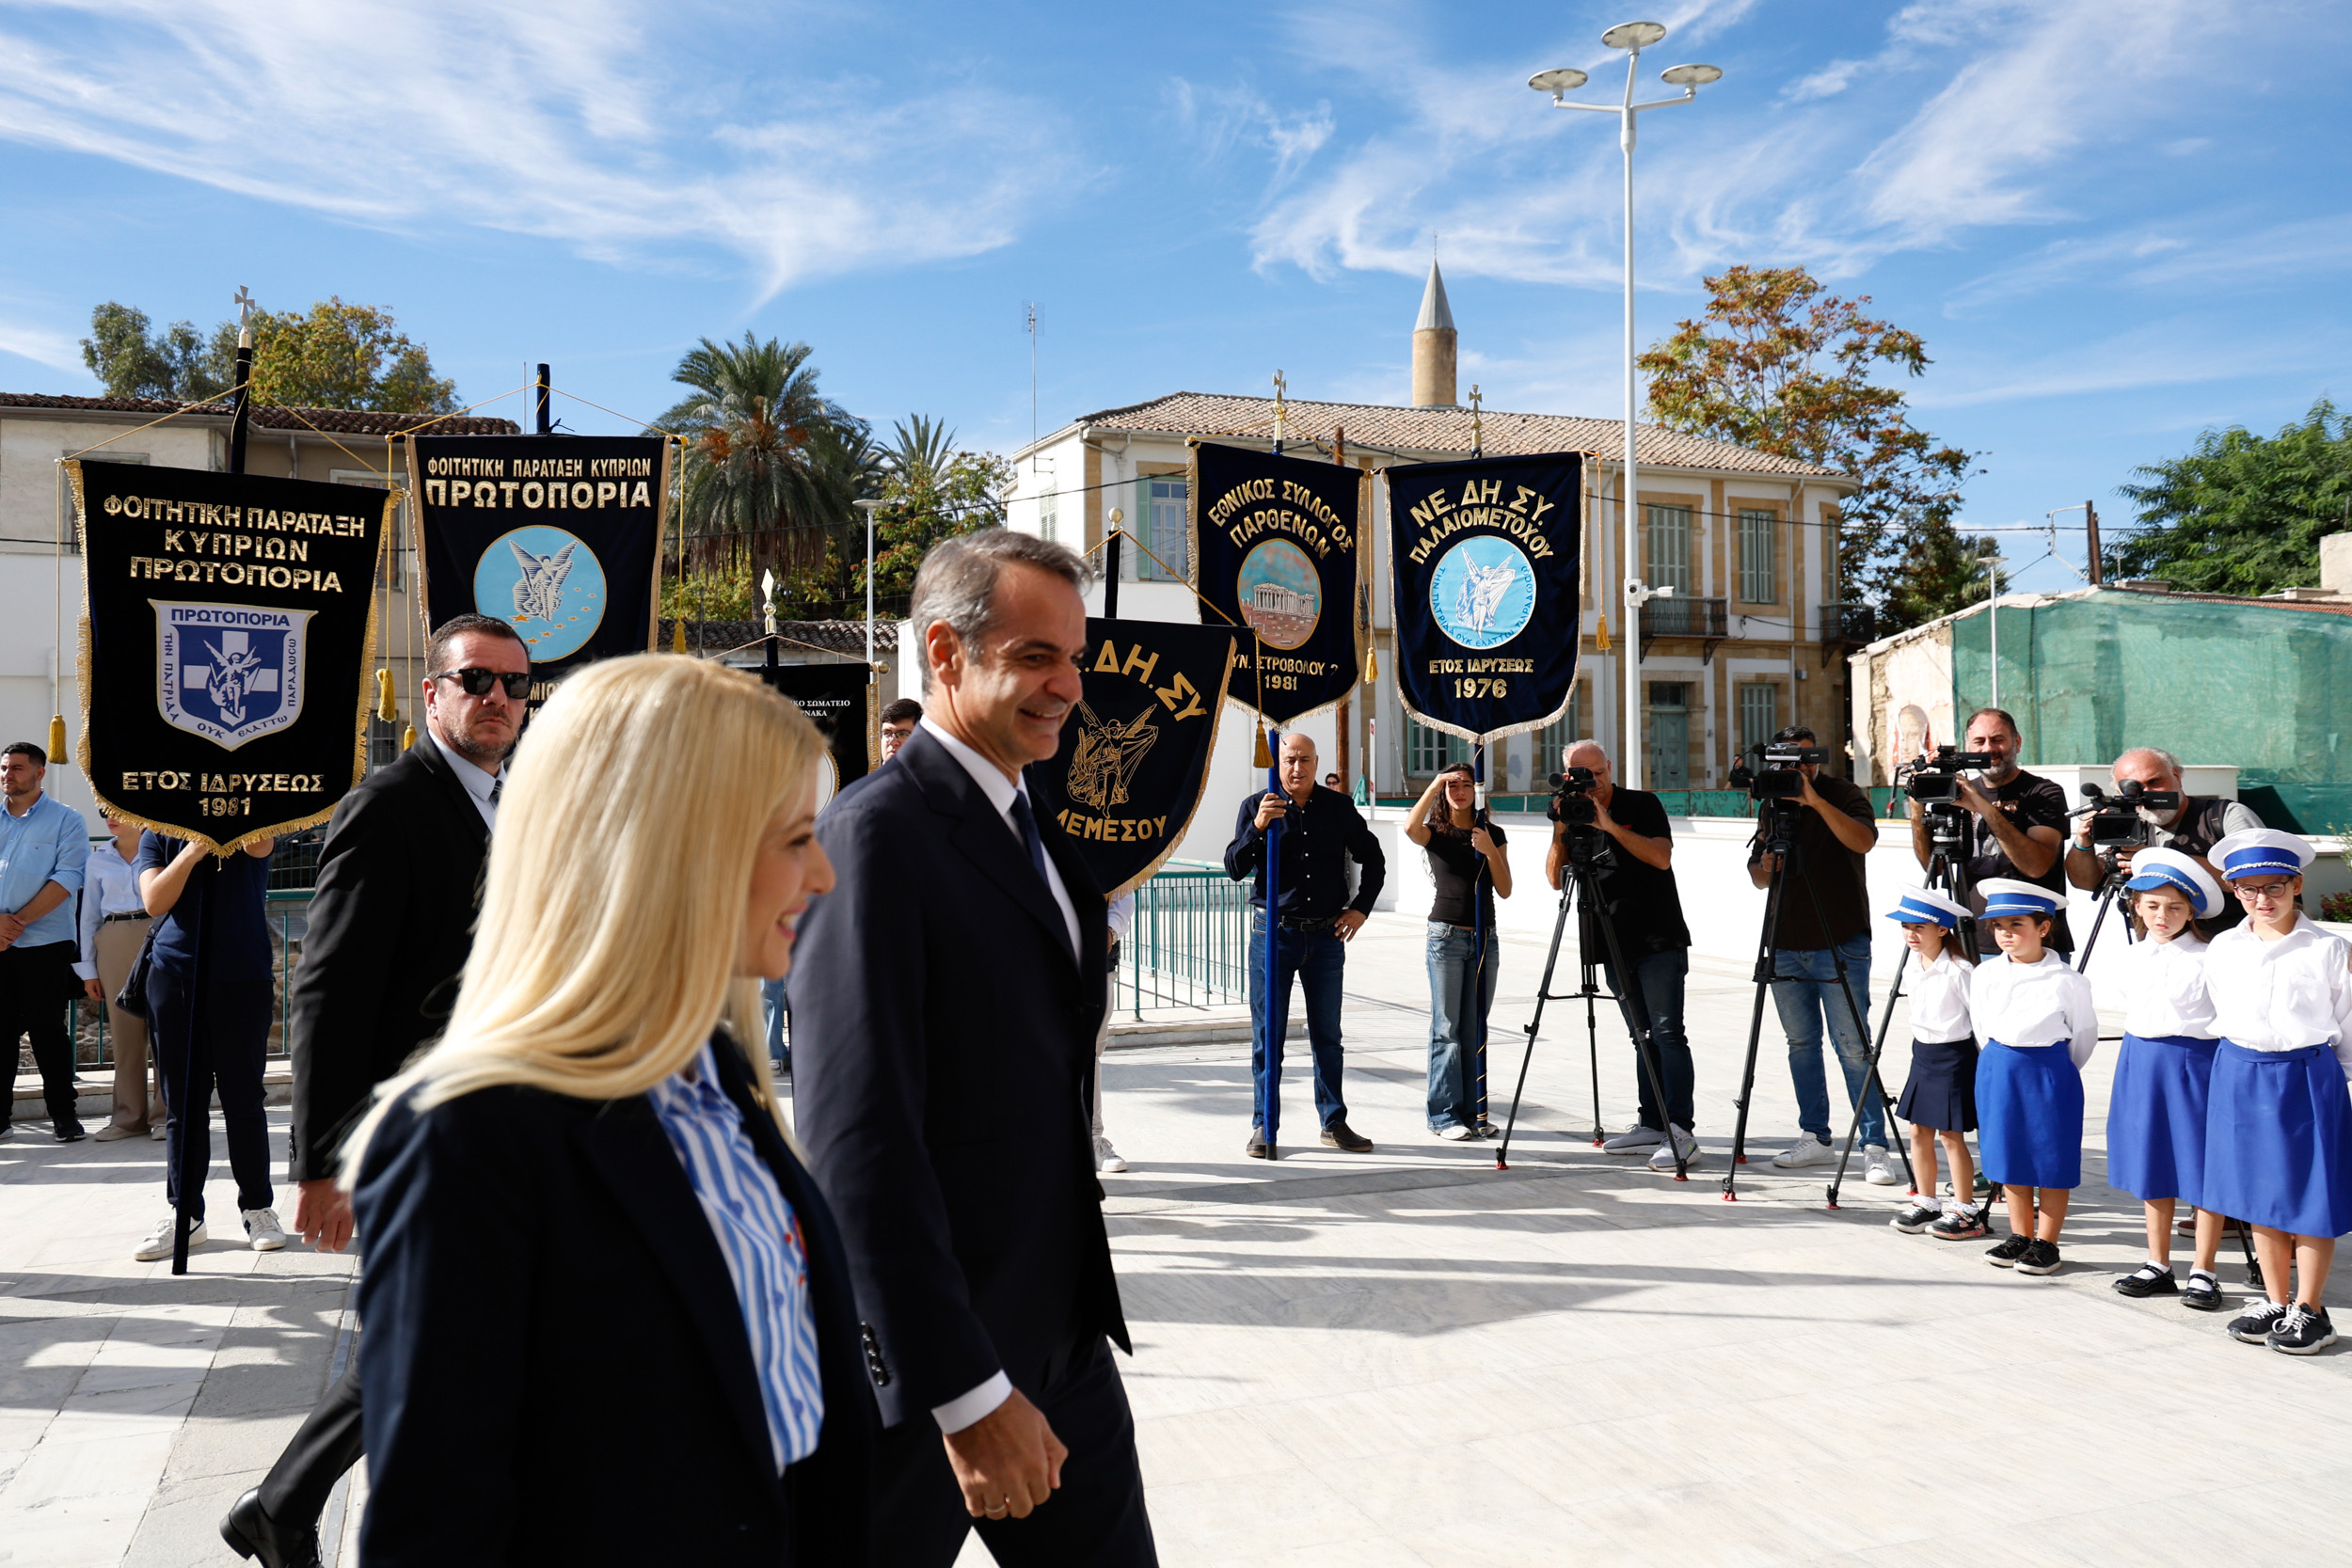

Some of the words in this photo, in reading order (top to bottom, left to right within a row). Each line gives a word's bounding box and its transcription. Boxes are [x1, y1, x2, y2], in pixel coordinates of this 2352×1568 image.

[427, 457, 504, 478] ΦΟΙΤΗΤΙΚΗ
[513, 458, 583, 478] ΠΑΡΑΤΑΞΗ
[591, 457, 652, 477] ΚΥΠΡΙΩΝ
[425, 479, 652, 510] ΠΡΩΤΟΠΟΡΙΑ
[103, 494, 242, 528] ΦΟΙΤΗΤΙΚΗ
[246, 507, 366, 538] ΠΑΡΑΤΑΞΗ
[1207, 478, 1276, 528] ΕΘΝΙΚΟΣ
[1281, 480, 1354, 554] ΣΥΛΛΟΓΟΣ
[164, 529, 309, 562] ΚΥΠΡΙΩΝ
[1229, 508, 1331, 561] ΠΑΡΘΕΝΩΝ
[1408, 506, 1554, 565] ΠΑΛΑΙΟΜΕΤΟΧΟΥ
[130, 556, 343, 594] ΠΡΩΤΟΠΟΡΙΑ
[171, 609, 291, 627] ΠΡΩΤΟΠΟΡΙΑ
[1232, 654, 1251, 670] ΥΝ.
[1429, 658, 1464, 674] ΕΤΟΣ
[1467, 657, 1534, 673] ΙΔΡΥΣΕΩΣ
[164, 633, 173, 657] ΤΗΝ
[197, 722, 226, 739] ΟΥΚ
[1264, 673, 1298, 691] 1981
[1454, 677, 1508, 699] 1976
[122, 770, 192, 790] ΕΤΟΣ
[200, 772, 325, 793] ΙΔΡΥΣΕΩΣ
[199, 797, 251, 816] 1981
